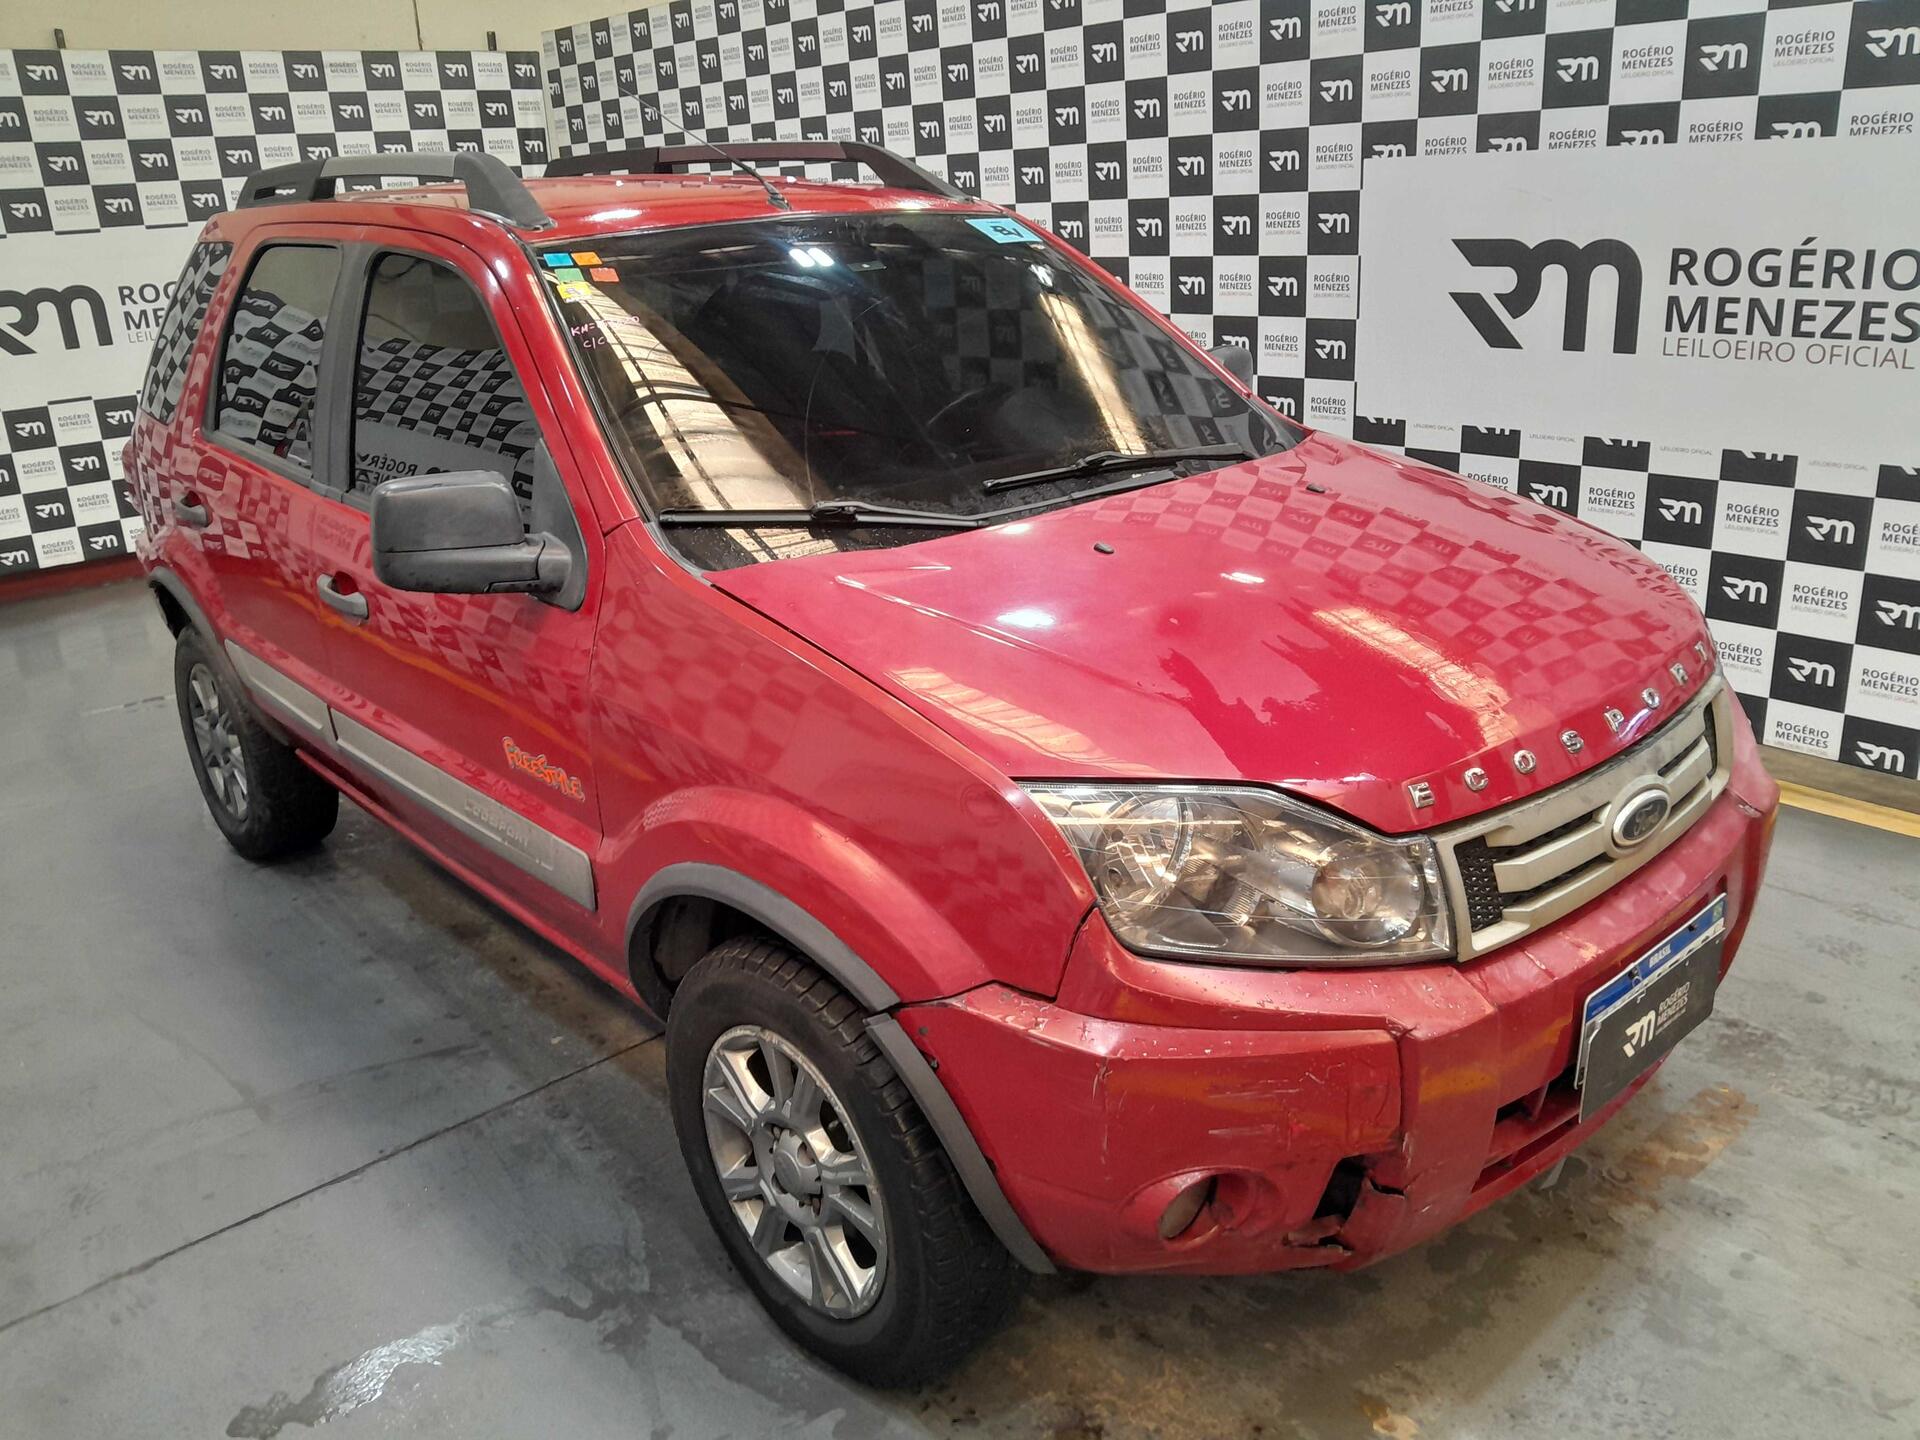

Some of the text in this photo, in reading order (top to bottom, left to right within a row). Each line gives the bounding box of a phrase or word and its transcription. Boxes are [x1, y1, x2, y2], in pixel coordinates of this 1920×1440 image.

[1318, 5, 1356, 19] ROGÉRIO
[1218, 20, 1253, 32] ROGÉRIO
[1318, 15, 1357, 28] MENEZES
[1129, 33, 1160, 45] ROGÉRIO
[1218, 29, 1253, 41] MENEZES
[1775, 29, 1835, 46] ROGÉRIO
[1130, 41, 1161, 54] MENEZES
[1622, 45, 1674, 59] ROGÉRIO
[1774, 42, 1834, 58] MENEZES
[1488, 58, 1534, 71] ROGÉRIO
[1621, 56, 1673, 70] MENEZES
[1370, 70, 1411, 82] ROGÉRIO
[1488, 68, 1534, 81] MENEZES
[1266, 80, 1302, 92] ROGÉRIO
[1370, 79, 1411, 92] MENEZES
[1173, 90, 1206, 101] ROGÉRIO
[1266, 90, 1302, 101] MENEZES
[1174, 99, 1206, 109] MENEZES
[1850, 111, 1914, 126] ROGÉRIO
[1689, 120, 1743, 133] ROGÉRIO
[1549, 128, 1597, 141] ROGÉRIO
[1425, 136, 1467, 148] ROGÉRIO
[1219, 149, 1252, 160] ROGÉRIO
[1316, 143, 1353, 154] ROGÉRIO
[1132, 155, 1162, 165] ROGÉRIO
[1219, 158, 1253, 168] MENEZES
[1316, 152, 1354, 163] MENEZES
[1132, 164, 1163, 173] MENEZES
[1175, 213, 1207, 223] ROGÉRIO
[1265, 209, 1301, 220] ROGÉRIO
[1175, 222, 1207, 231] MENEZES
[1265, 220, 1301, 229] MENEZES
[1669, 236, 1920, 291] ROGÉRIO
[1219, 272, 1252, 282] ROGÉRIO
[1313, 272, 1350, 283] ROGÉRIO
[1219, 282, 1252, 290] MENEZES
[1313, 282, 1350, 292] MENEZES
[1664, 296, 1920, 343] MENEZES
[1264, 333, 1298, 343] ROGÉRIO
[1264, 342, 1299, 352] MENEZES
[1662, 337, 1916, 370] LEILOEIRO OFICIAL
[1310, 396, 1346, 407] ROGÉRIO
[1310, 405, 1346, 416] MENEZES
[1588, 487, 1636, 500] ROGÉRIO
[1588, 496, 1635, 511] MENEZES
[1726, 503, 1780, 518] ROGÉRIO
[1725, 513, 1779, 529] MENEZES
[1793, 584, 1848, 601] ROGÉRIO
[1792, 594, 1848, 610] MENEZES
[1862, 668, 1919, 687] ROGÉRIO
[1860, 678, 1918, 697] MENEZES
[1408, 641, 1708, 808] ECOSPORT
[1776, 721, 1830, 739] ROGÉRIO
[1775, 730, 1828, 749] MENEZES
